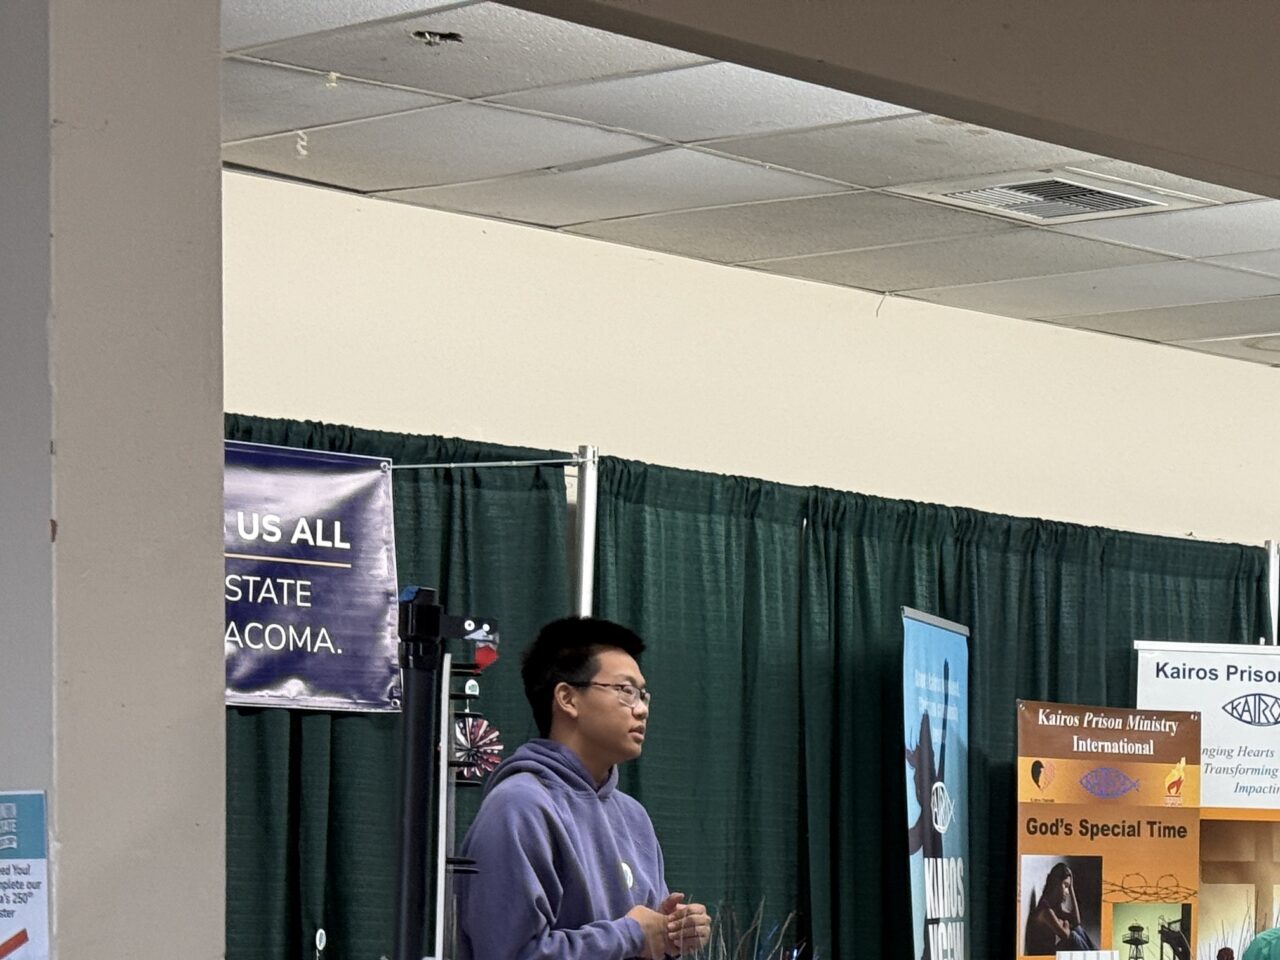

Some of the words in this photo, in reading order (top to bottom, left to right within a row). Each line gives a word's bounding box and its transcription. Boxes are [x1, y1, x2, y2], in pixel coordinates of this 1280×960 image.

[237, 511, 282, 543] US
[290, 517, 351, 549] ALL
[225, 574, 312, 608] STATE
[225, 620, 343, 655] ACOMA.
[1155, 662, 1219, 681] Kairos
[1038, 708, 1080, 727] Kairos
[1083, 712, 1123, 730] Prison
[1126, 714, 1179, 736] Ministry
[1072, 735, 1154, 755] International
[1202, 747, 1234, 761] nging
[1237, 746, 1275, 759] Hearts
[1203, 763, 1279, 779] Transforming
[1079, 820, 1142, 841] Special
[1146, 821, 1188, 838] Time
